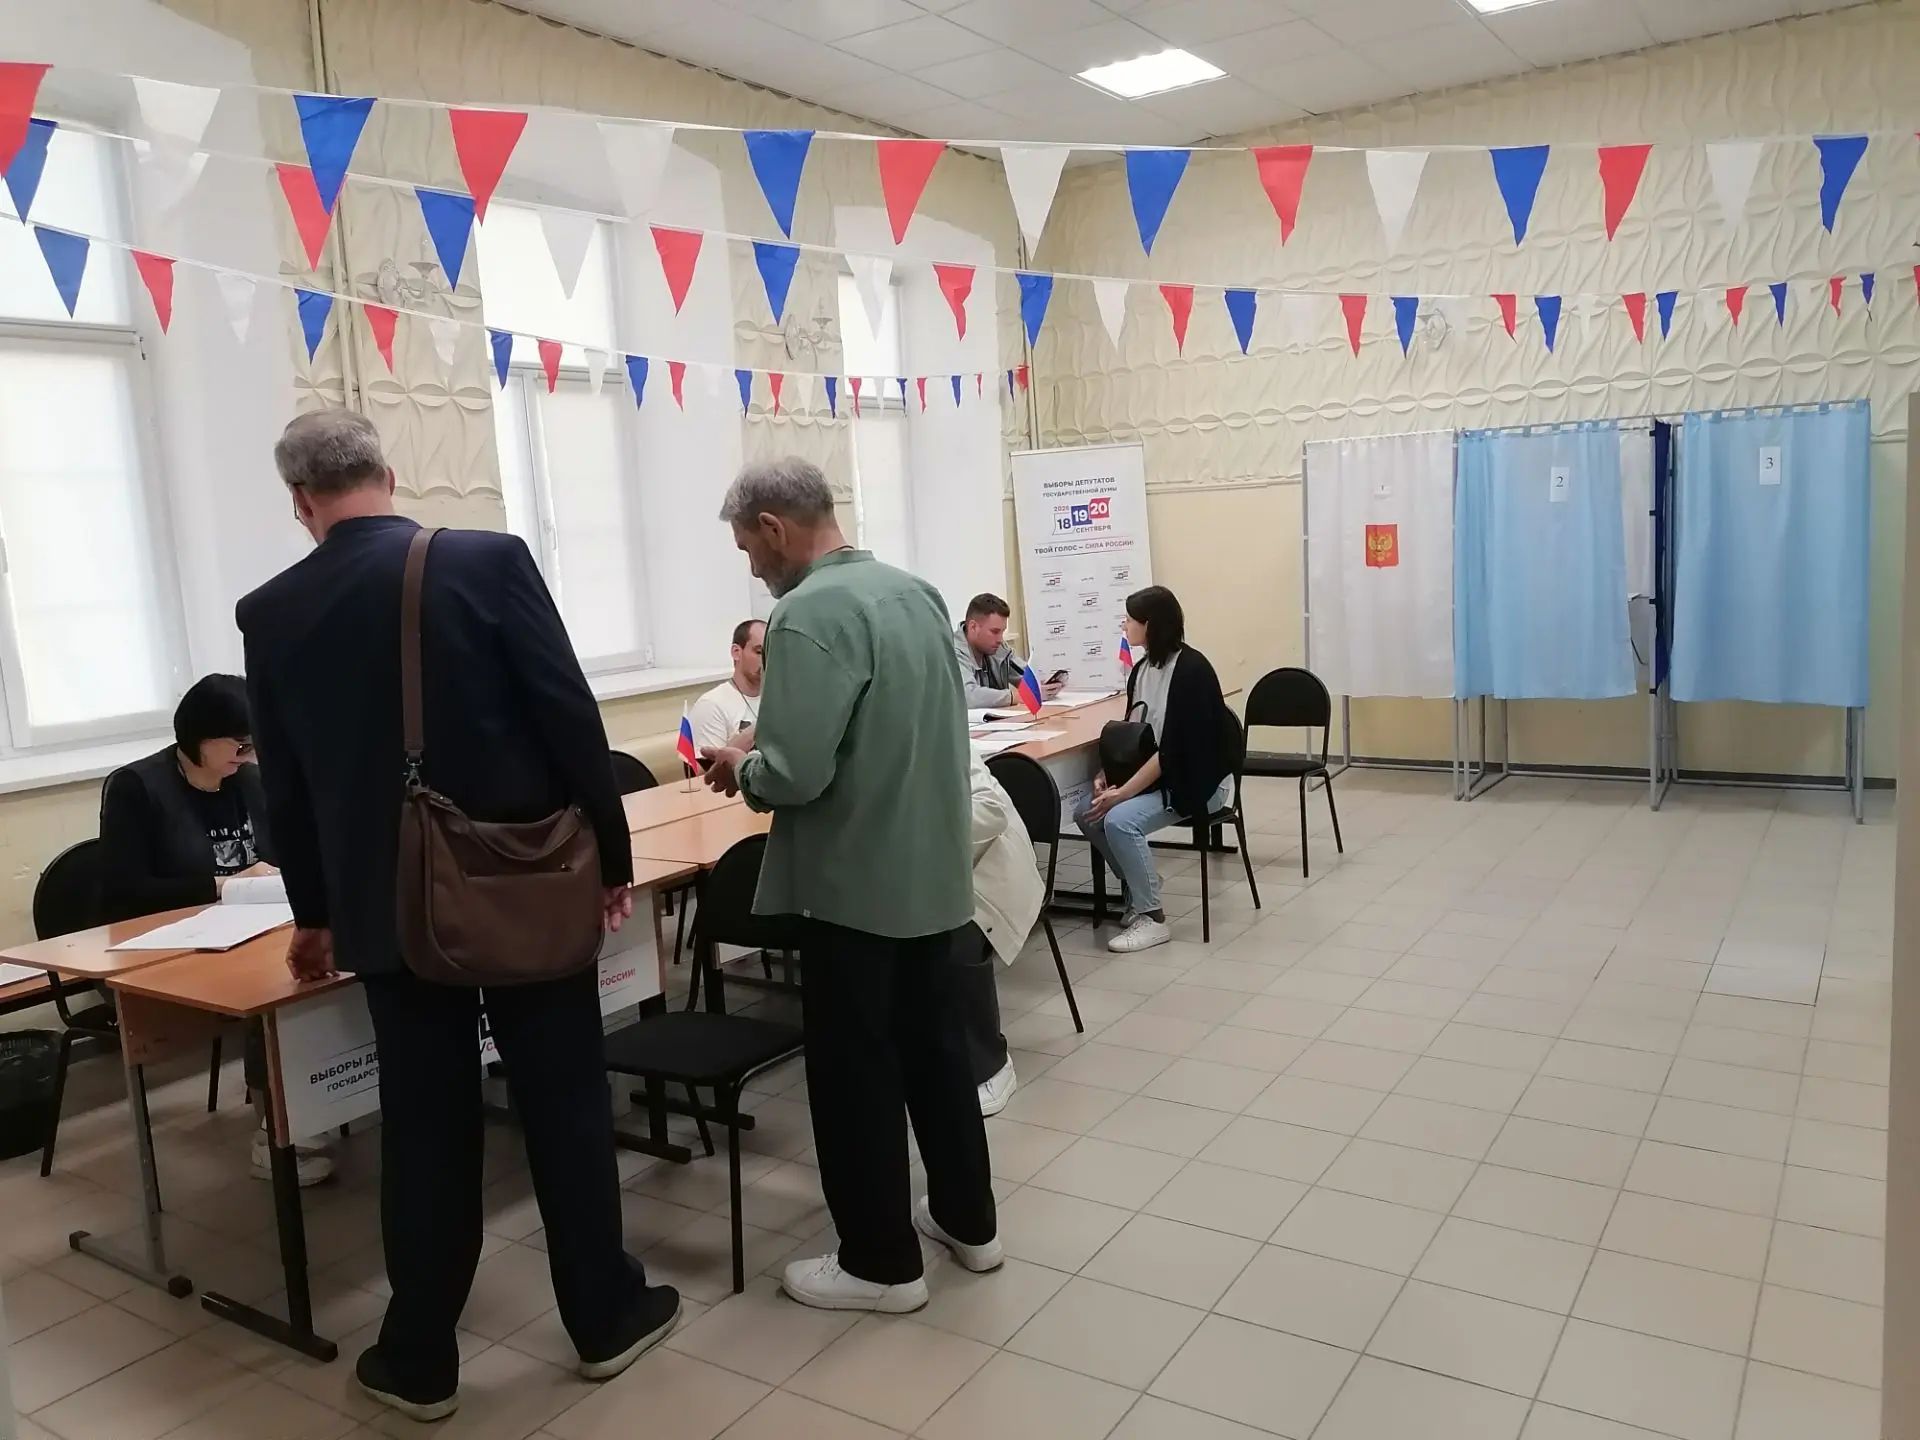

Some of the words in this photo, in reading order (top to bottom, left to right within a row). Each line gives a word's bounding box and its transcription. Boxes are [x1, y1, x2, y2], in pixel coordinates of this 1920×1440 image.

[1765, 457, 1774, 470] 3
[1043, 481, 1074, 489] ВЫБОРЫ
[1075, 477, 1115, 487] ДЕПУТАТОВ
[1555, 476, 1564, 488] 2
[1042, 487, 1099, 498] ГОСУДАРСТВЕННОЙ
[1099, 486, 1118, 494] ДУМЫ
[1057, 518, 1072, 530] 18
[1073, 509, 1088, 522] 19
[1090, 502, 1108, 515] 20
[1076, 524, 1112, 534] СЕНТЯБРЯ
[1034, 546, 1054, 554] ТВОЙ
[1054, 544, 1078, 553] ГОЛОС
[600, 968, 636, 988] РОССИИ!
[310, 1056, 363, 1084] ВЫБОРЫ
[327, 1067, 379, 1092] ГОСУДАРСТ
